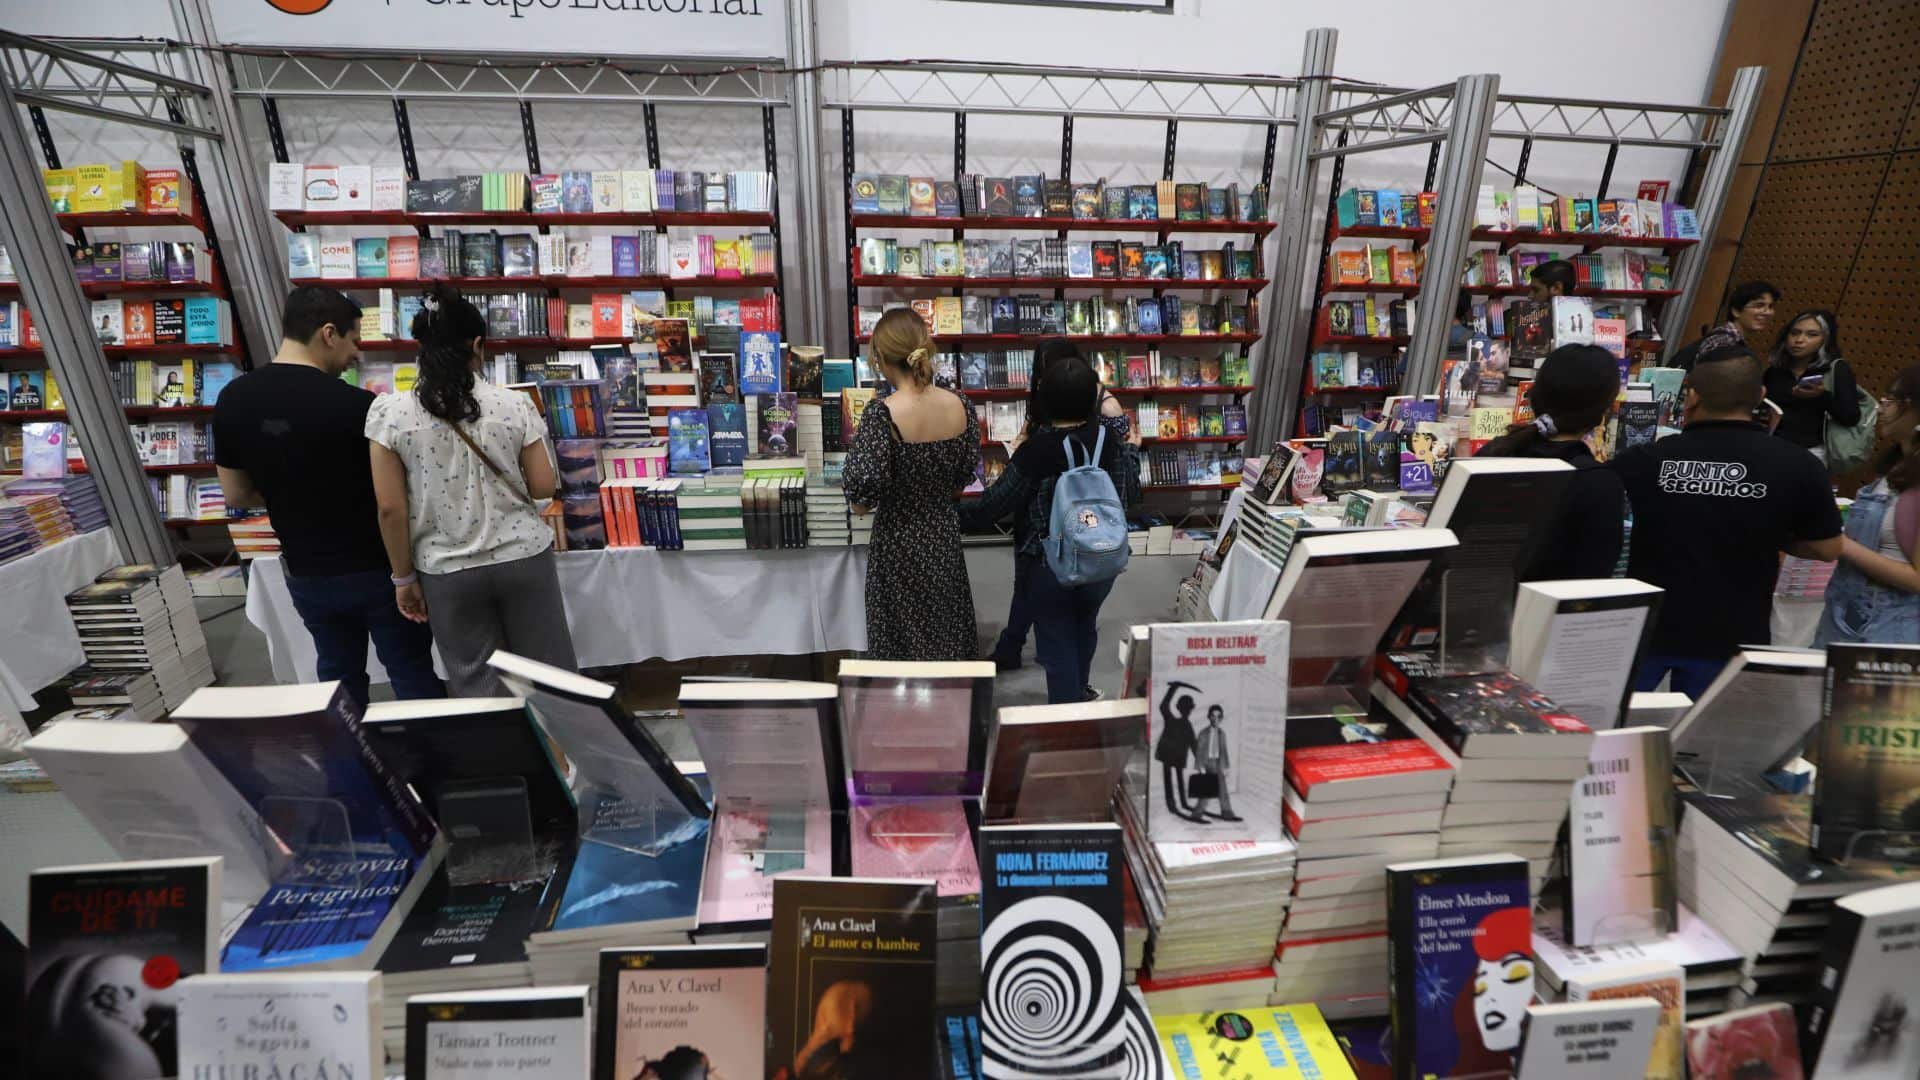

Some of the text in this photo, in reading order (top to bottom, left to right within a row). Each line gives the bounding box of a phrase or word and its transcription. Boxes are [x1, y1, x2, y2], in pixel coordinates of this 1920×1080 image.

[1660, 460, 1748, 481] PUNTO
[1663, 478, 1768, 499] SEGUIMOS
[1187, 636, 1213, 650] ROSA
[1857, 661, 1913, 673] MARIO
[303, 858, 409, 881] Segovia
[996, 848, 1109, 872] NONA FERNÁNDEZ
[268, 883, 403, 908] Peregrinos
[1418, 889, 1511, 911] Élmer Mendoza
[812, 917, 876, 933] Ana Clavel
[813, 933, 921, 952] El amor es hambre
[626, 975, 722, 995] Ana V. Clavel
[434, 1030, 558, 1050] Tamara Trottner
